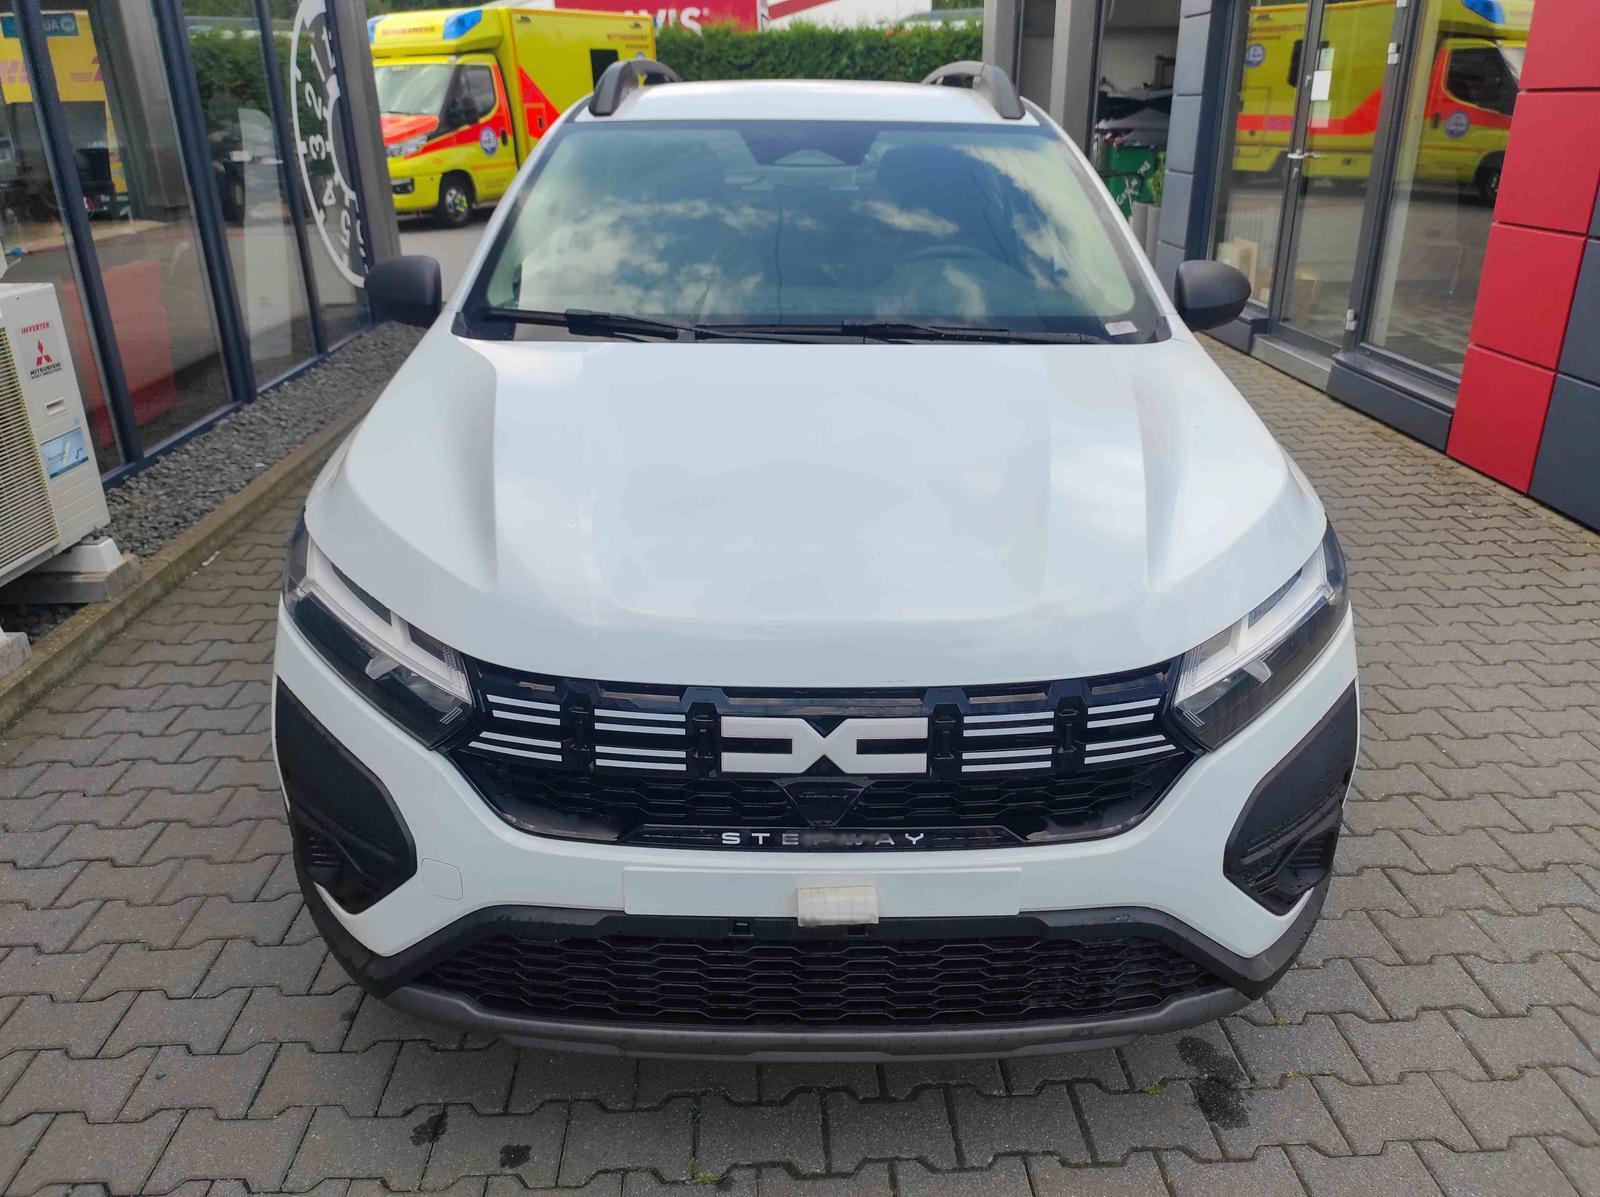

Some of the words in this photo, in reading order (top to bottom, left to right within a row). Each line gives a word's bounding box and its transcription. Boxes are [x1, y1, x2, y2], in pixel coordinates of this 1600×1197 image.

[624, 6, 703, 37] VIS
[304, 82, 322, 121] 2
[308, 133, 326, 161] 3
[21, 321, 50, 335] INVERTER
[30, 362, 61, 376] MITSUBISHI
[721, 831, 925, 846] STEPWAY
